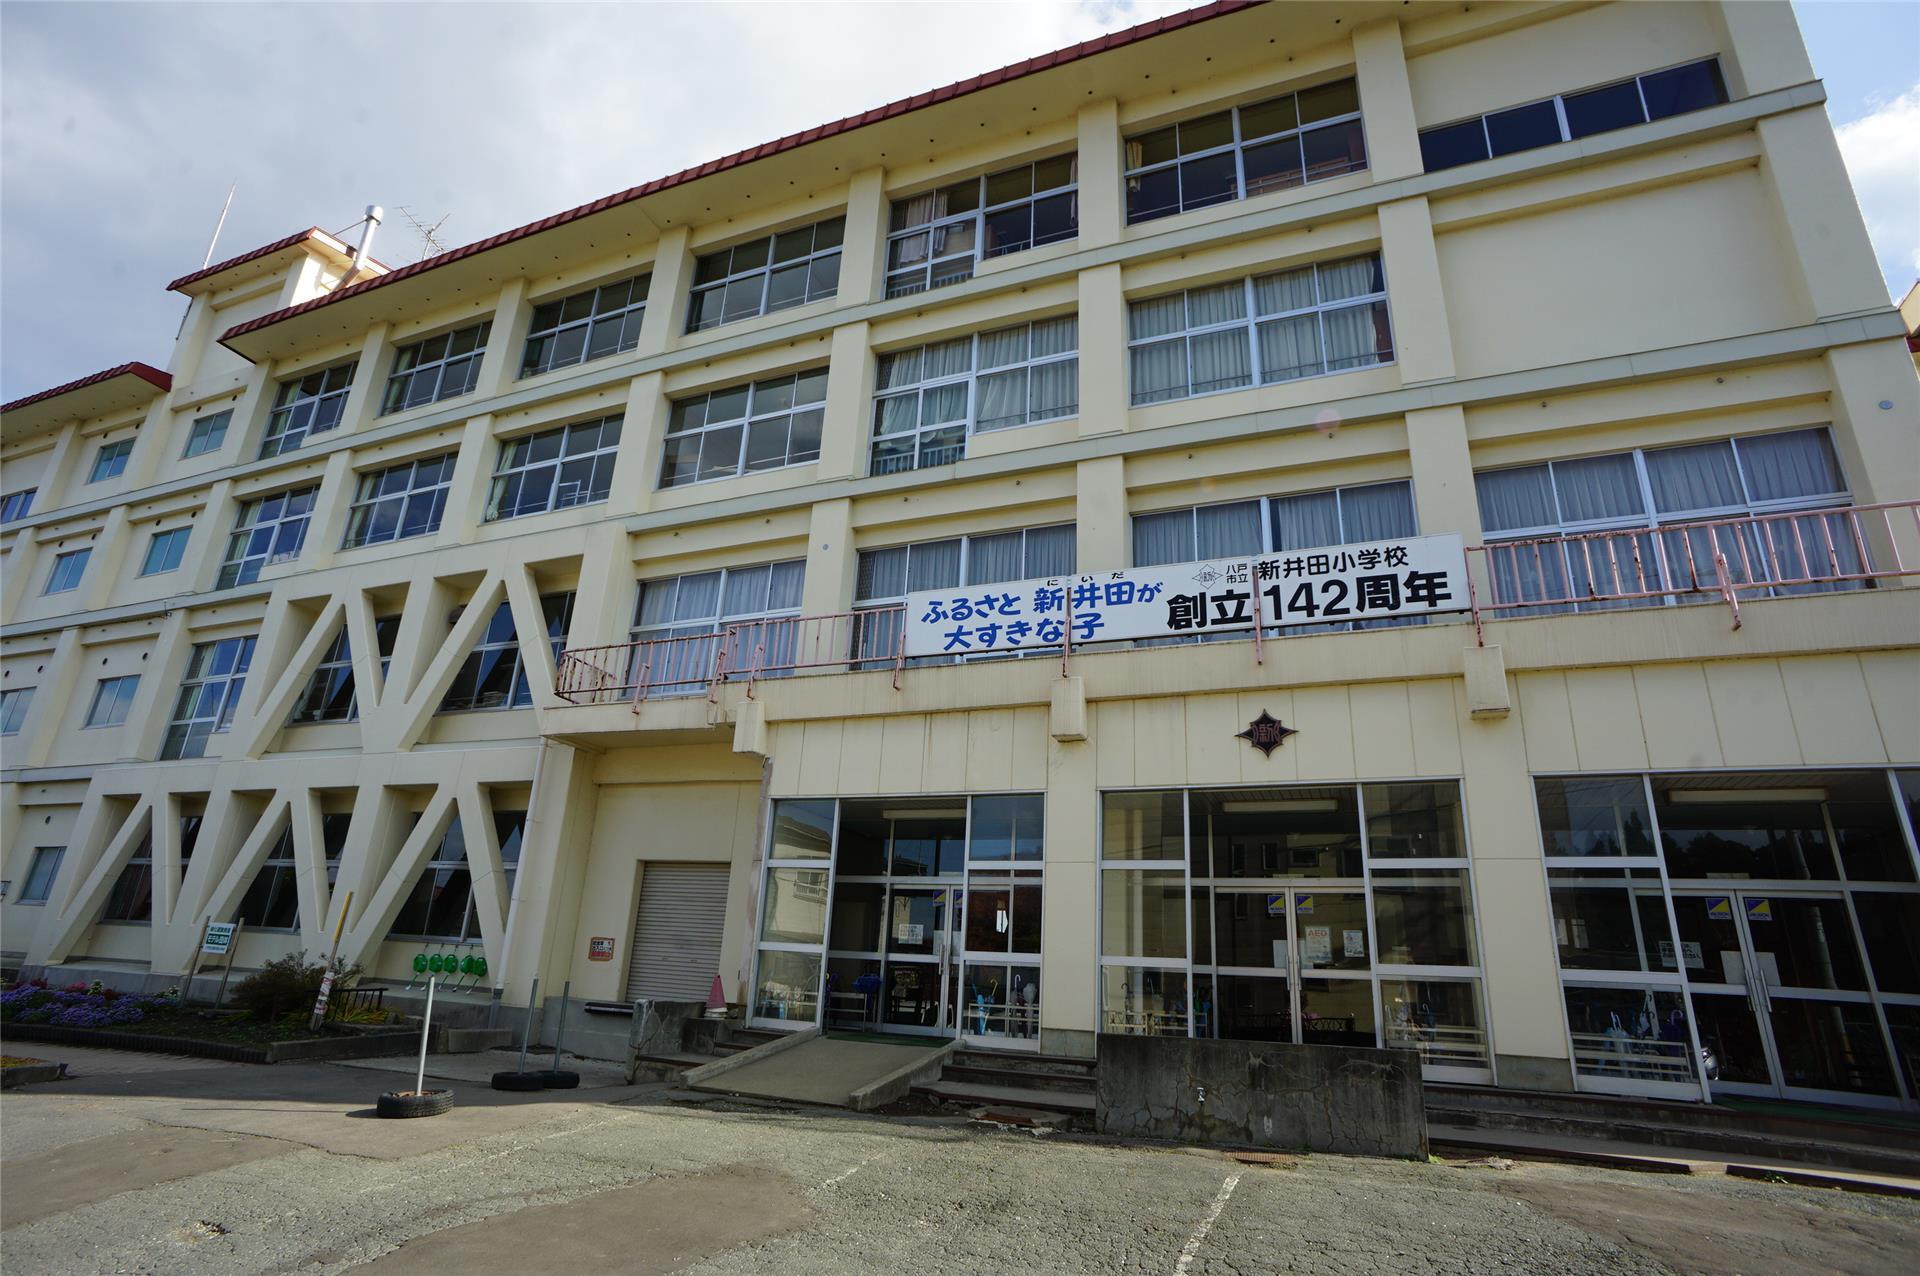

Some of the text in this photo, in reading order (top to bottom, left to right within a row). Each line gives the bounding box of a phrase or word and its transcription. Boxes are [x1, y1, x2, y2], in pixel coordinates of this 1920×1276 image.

[1226, 563, 1248, 574] 八戸
[1226, 574, 1248, 584] 市立
[1258, 546, 1409, 581] 新井田小学校
[920, 581, 1163, 624] ふるさと 新井田が
[1166, 570, 1452, 630] 創立142周年
[943, 613, 1105, 651] 大すきな子
[1308, 929, 1328, 937] AED
